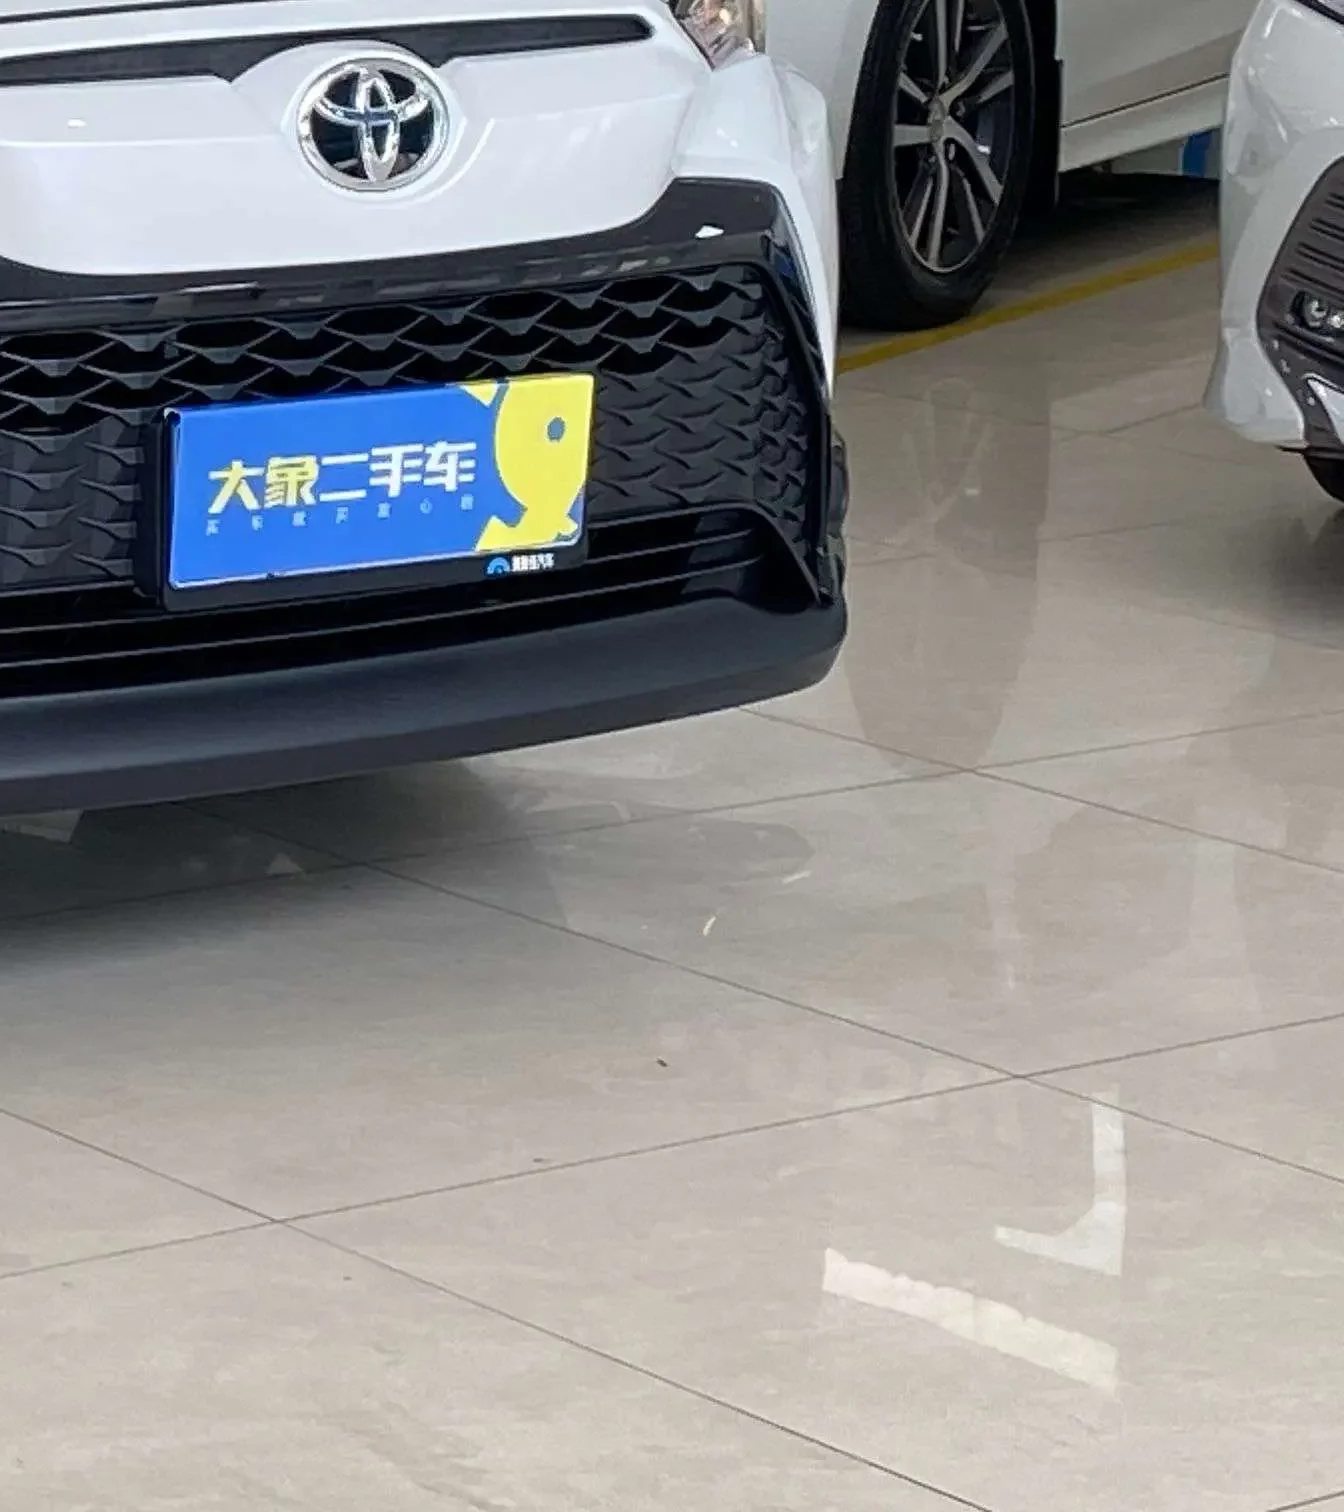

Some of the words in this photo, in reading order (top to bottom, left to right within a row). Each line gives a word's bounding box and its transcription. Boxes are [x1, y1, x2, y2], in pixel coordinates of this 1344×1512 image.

[208, 441, 477, 514] 大象二手车
